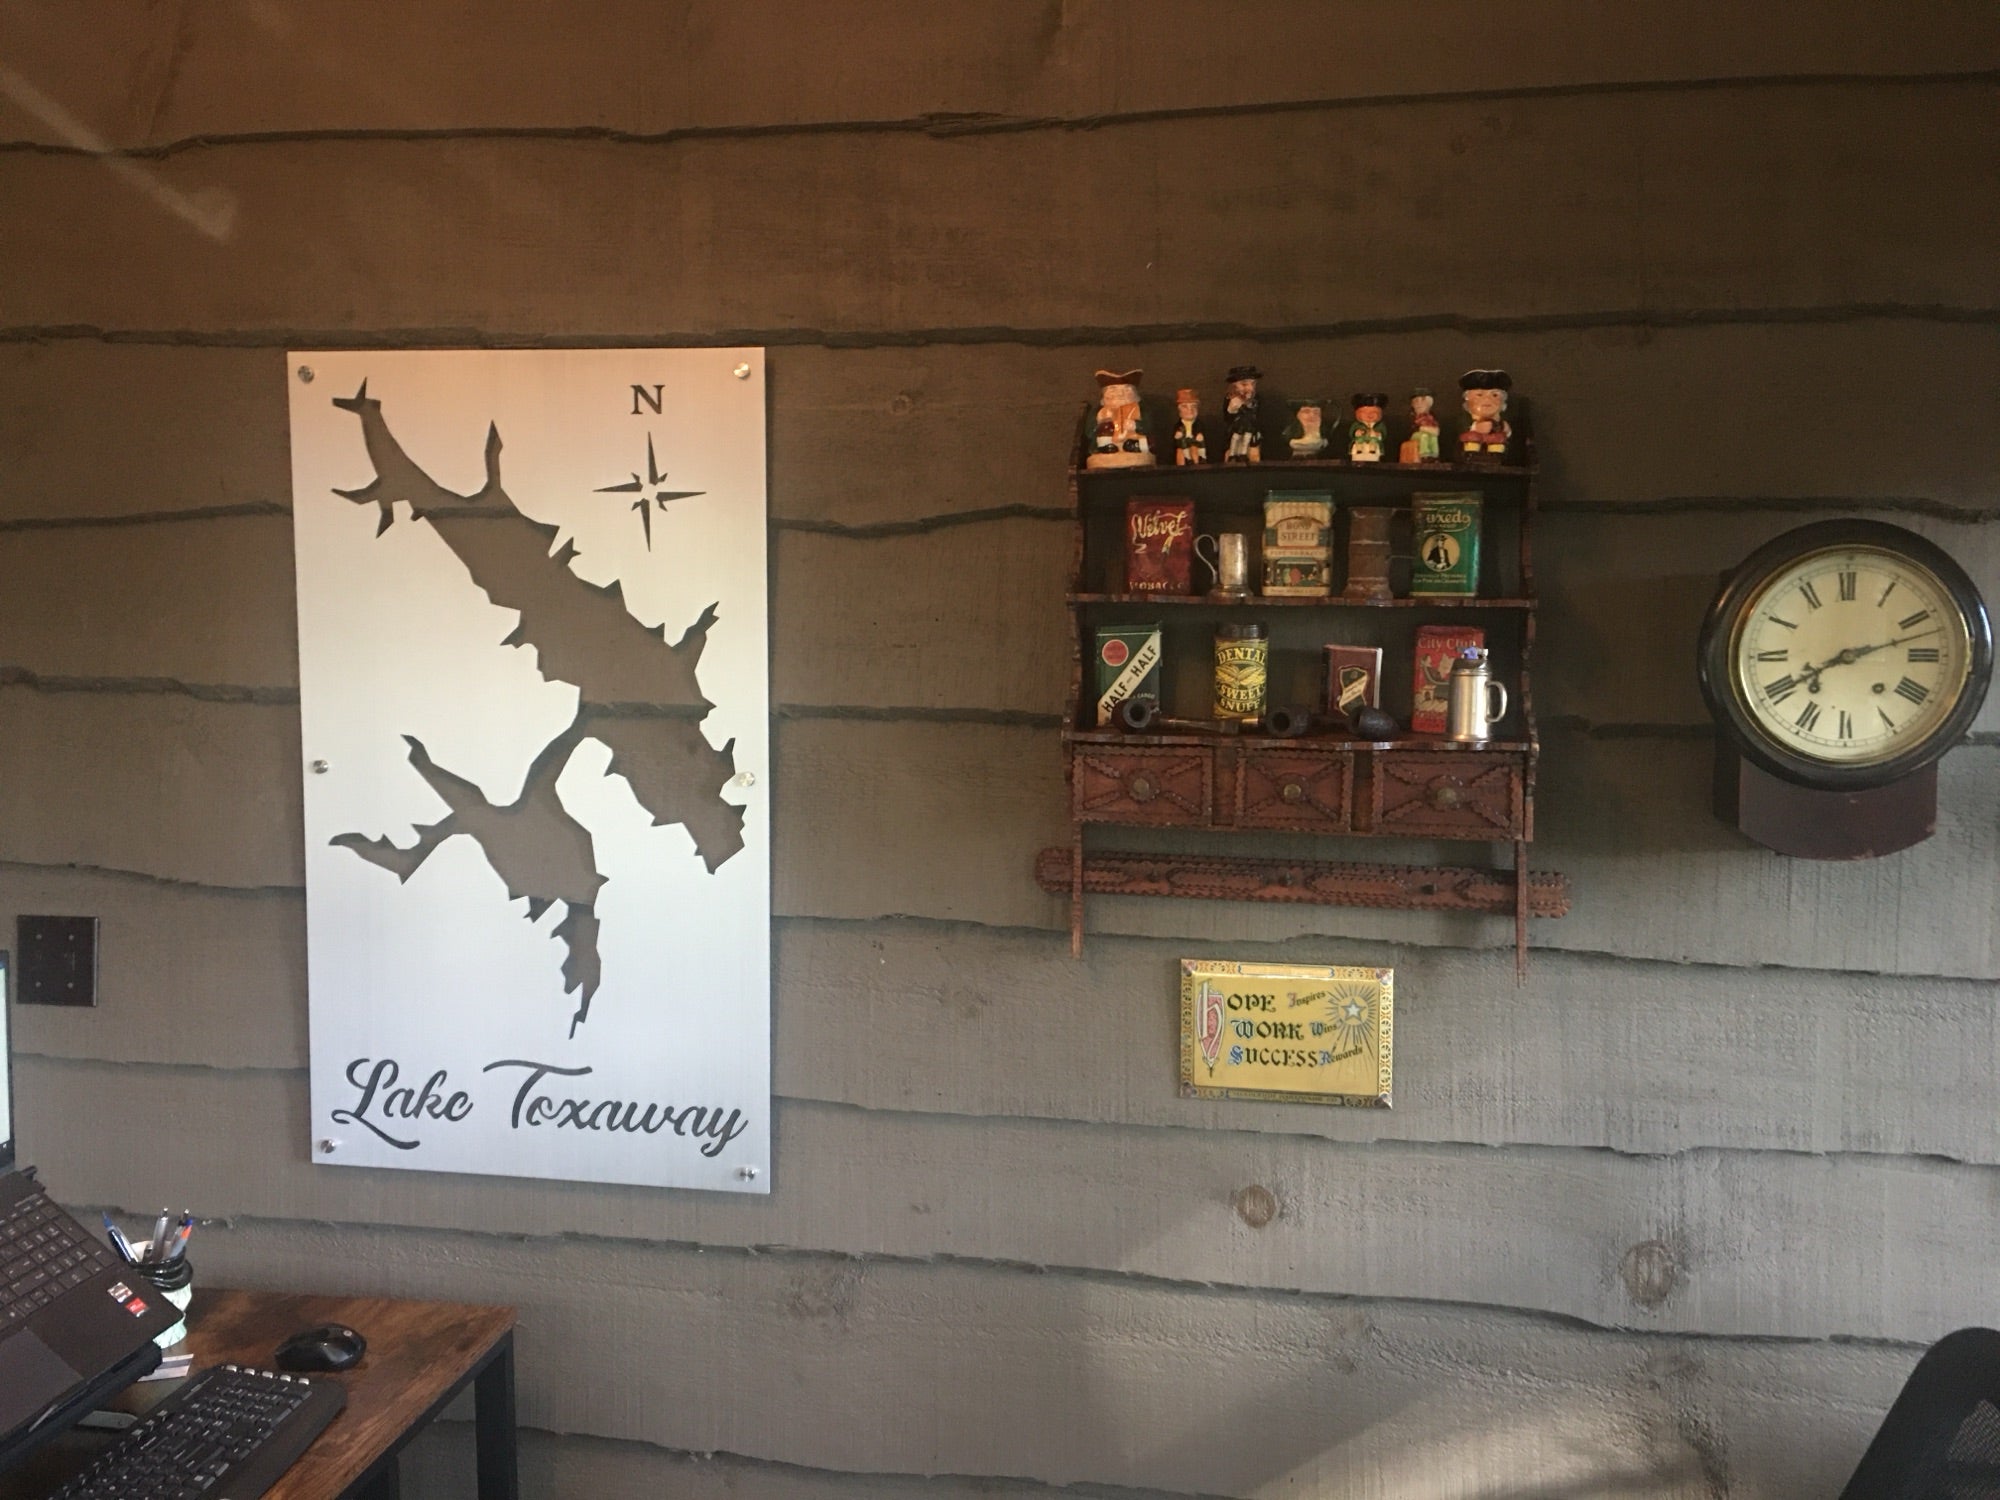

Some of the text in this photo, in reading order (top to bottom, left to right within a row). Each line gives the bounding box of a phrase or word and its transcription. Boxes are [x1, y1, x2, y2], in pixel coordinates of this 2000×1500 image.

[630, 384, 665, 415] N
[1418, 507, 1472, 524] uxedo
[1131, 510, 1191, 554] Velvet
[1282, 532, 1315, 541] STREET
[1419, 638, 1443, 652] City
[1217, 647, 1265, 665] DENTAL
[1101, 681, 1128, 713] HALF
[1130, 645, 1157, 677] HALF
[1221, 684, 1261, 700] SWEET
[1221, 698, 1261, 713] SNUFF
[1227, 1045, 1363, 1068] SUCCESS Rewards
[331, 1058, 474, 1150] Lake
